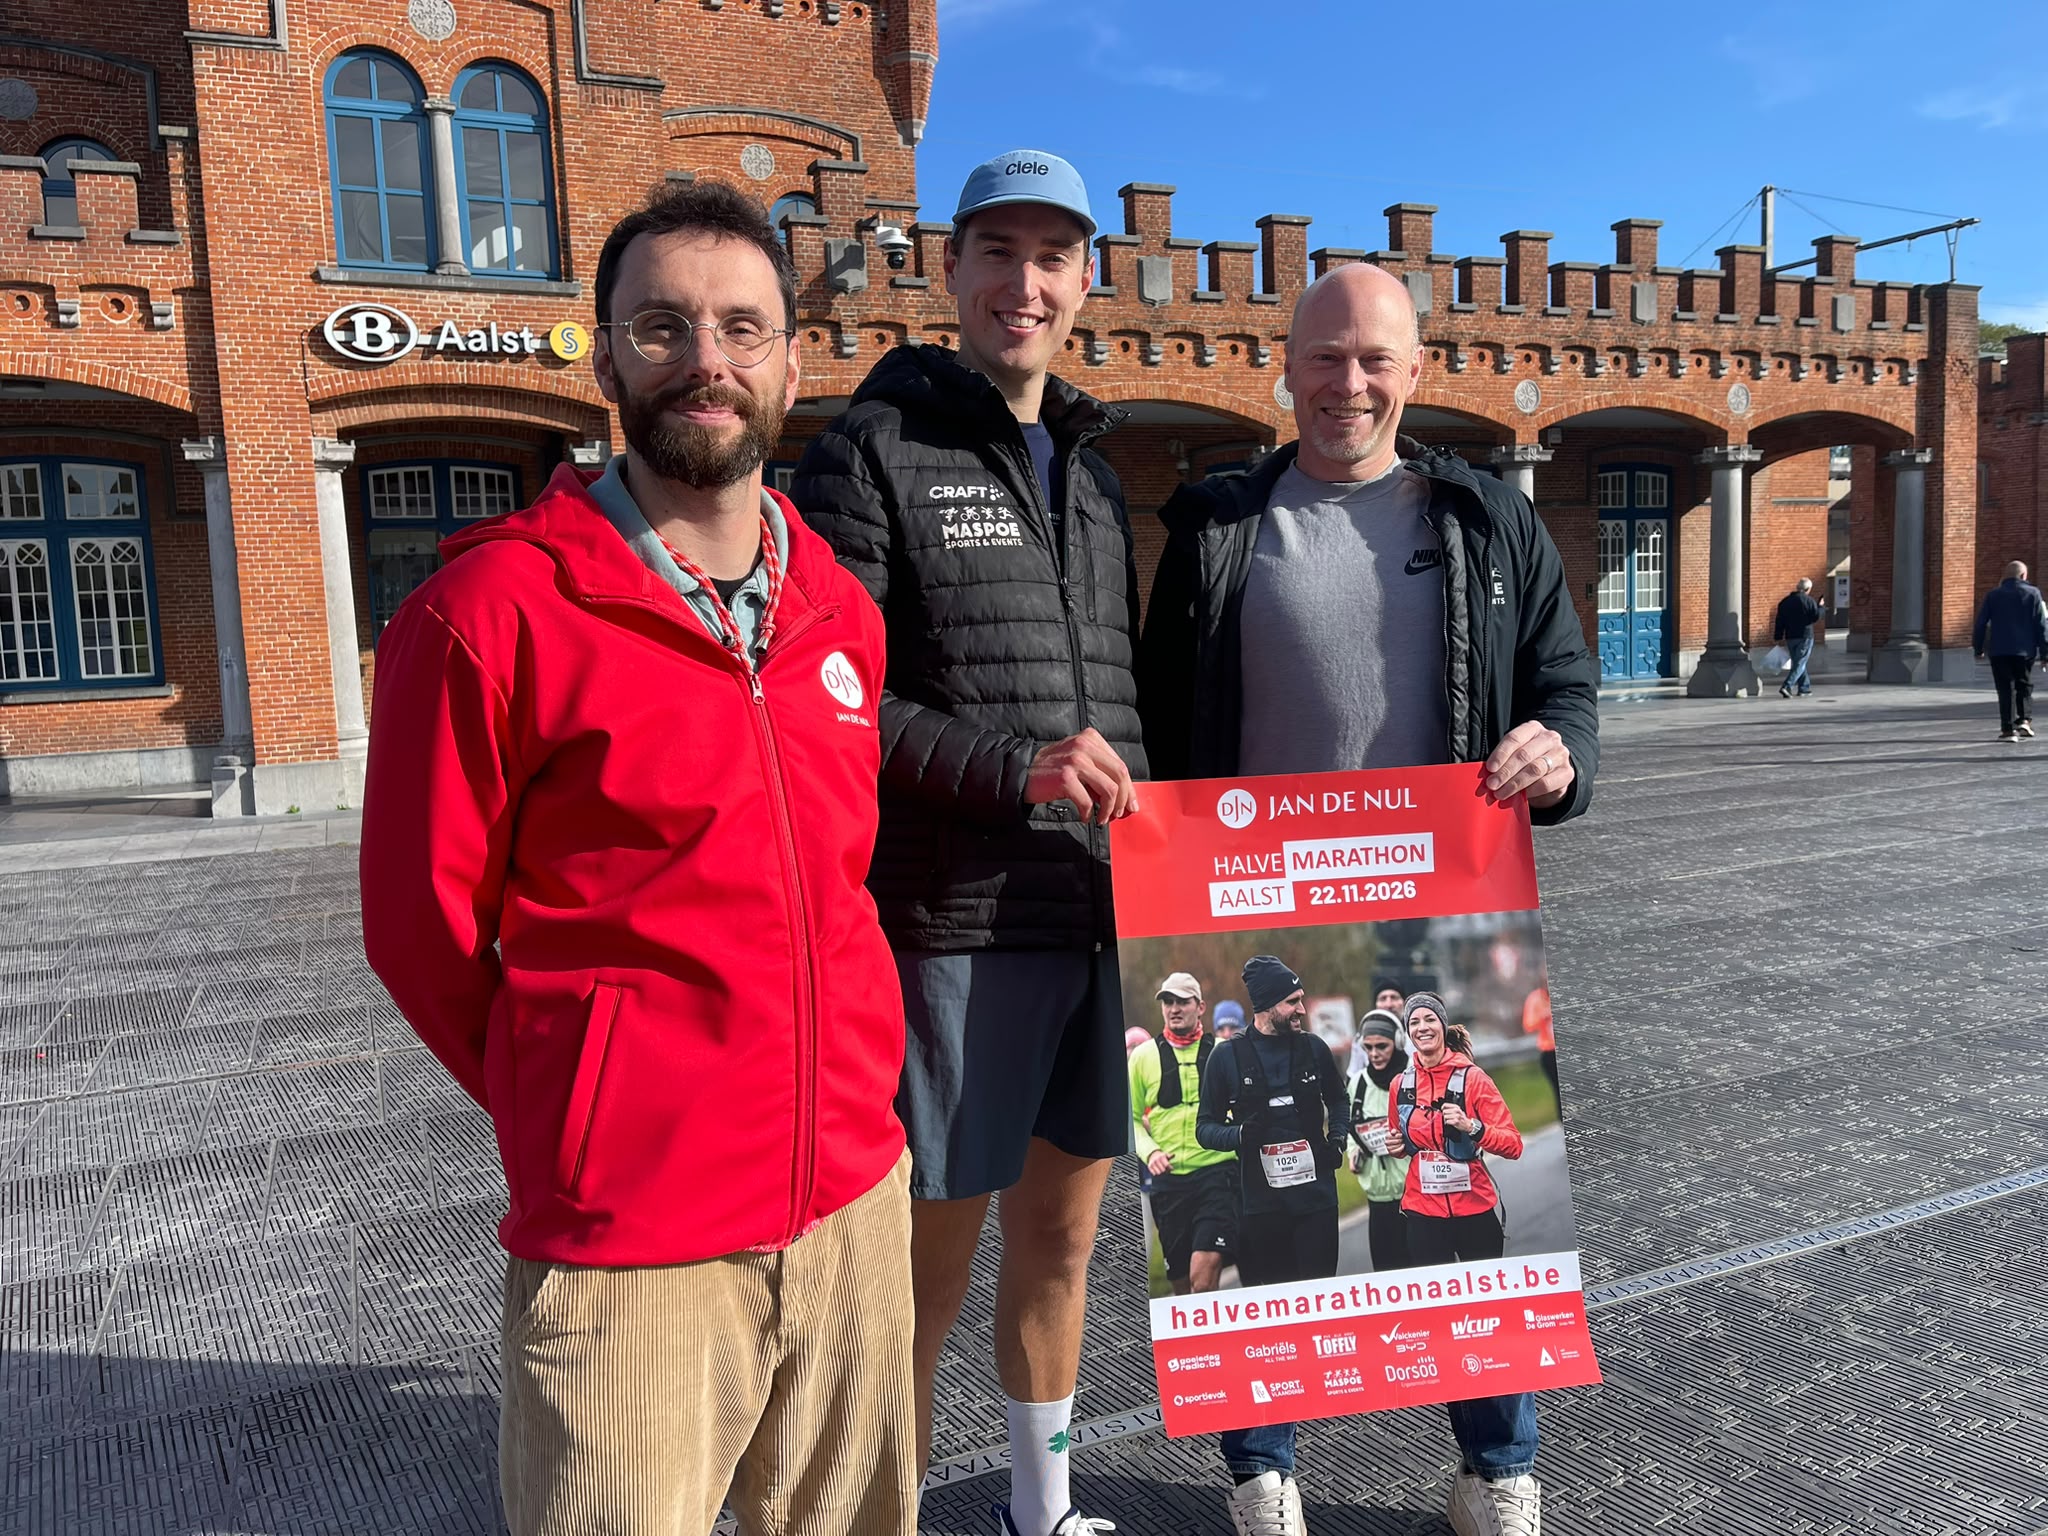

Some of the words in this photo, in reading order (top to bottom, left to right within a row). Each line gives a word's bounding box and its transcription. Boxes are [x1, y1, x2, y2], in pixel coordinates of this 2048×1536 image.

[436, 319, 535, 354] Aalst
[929, 485, 988, 499] CRAFT
[941, 522, 1021, 539] MASPOE
[945, 540, 980, 550] SPORTS
[982, 539, 990, 547] &
[991, 538, 1024, 547] EVENTS
[1268, 794, 1315, 820] JAN
[1322, 791, 1356, 813] DE
[1363, 787, 1417, 811] NUL
[1213, 852, 1283, 876] HALVE
[1292, 843, 1426, 871] MARATHON
[1219, 886, 1285, 909] AALST
[1309, 880, 1417, 906] 22.11.2026
[1276, 1155, 1298, 1166] 1026
[1432, 1164, 1452, 1173] 1025
[1171, 1264, 1560, 1330] halvemarathonaalst.be
[1450, 1314, 1501, 1336] WCUP
[1244, 1341, 1297, 1359] Gabriëls
[1324, 1375, 1363, 1389] MASPOE
[1385, 1362, 1439, 1383] Dorsoo
